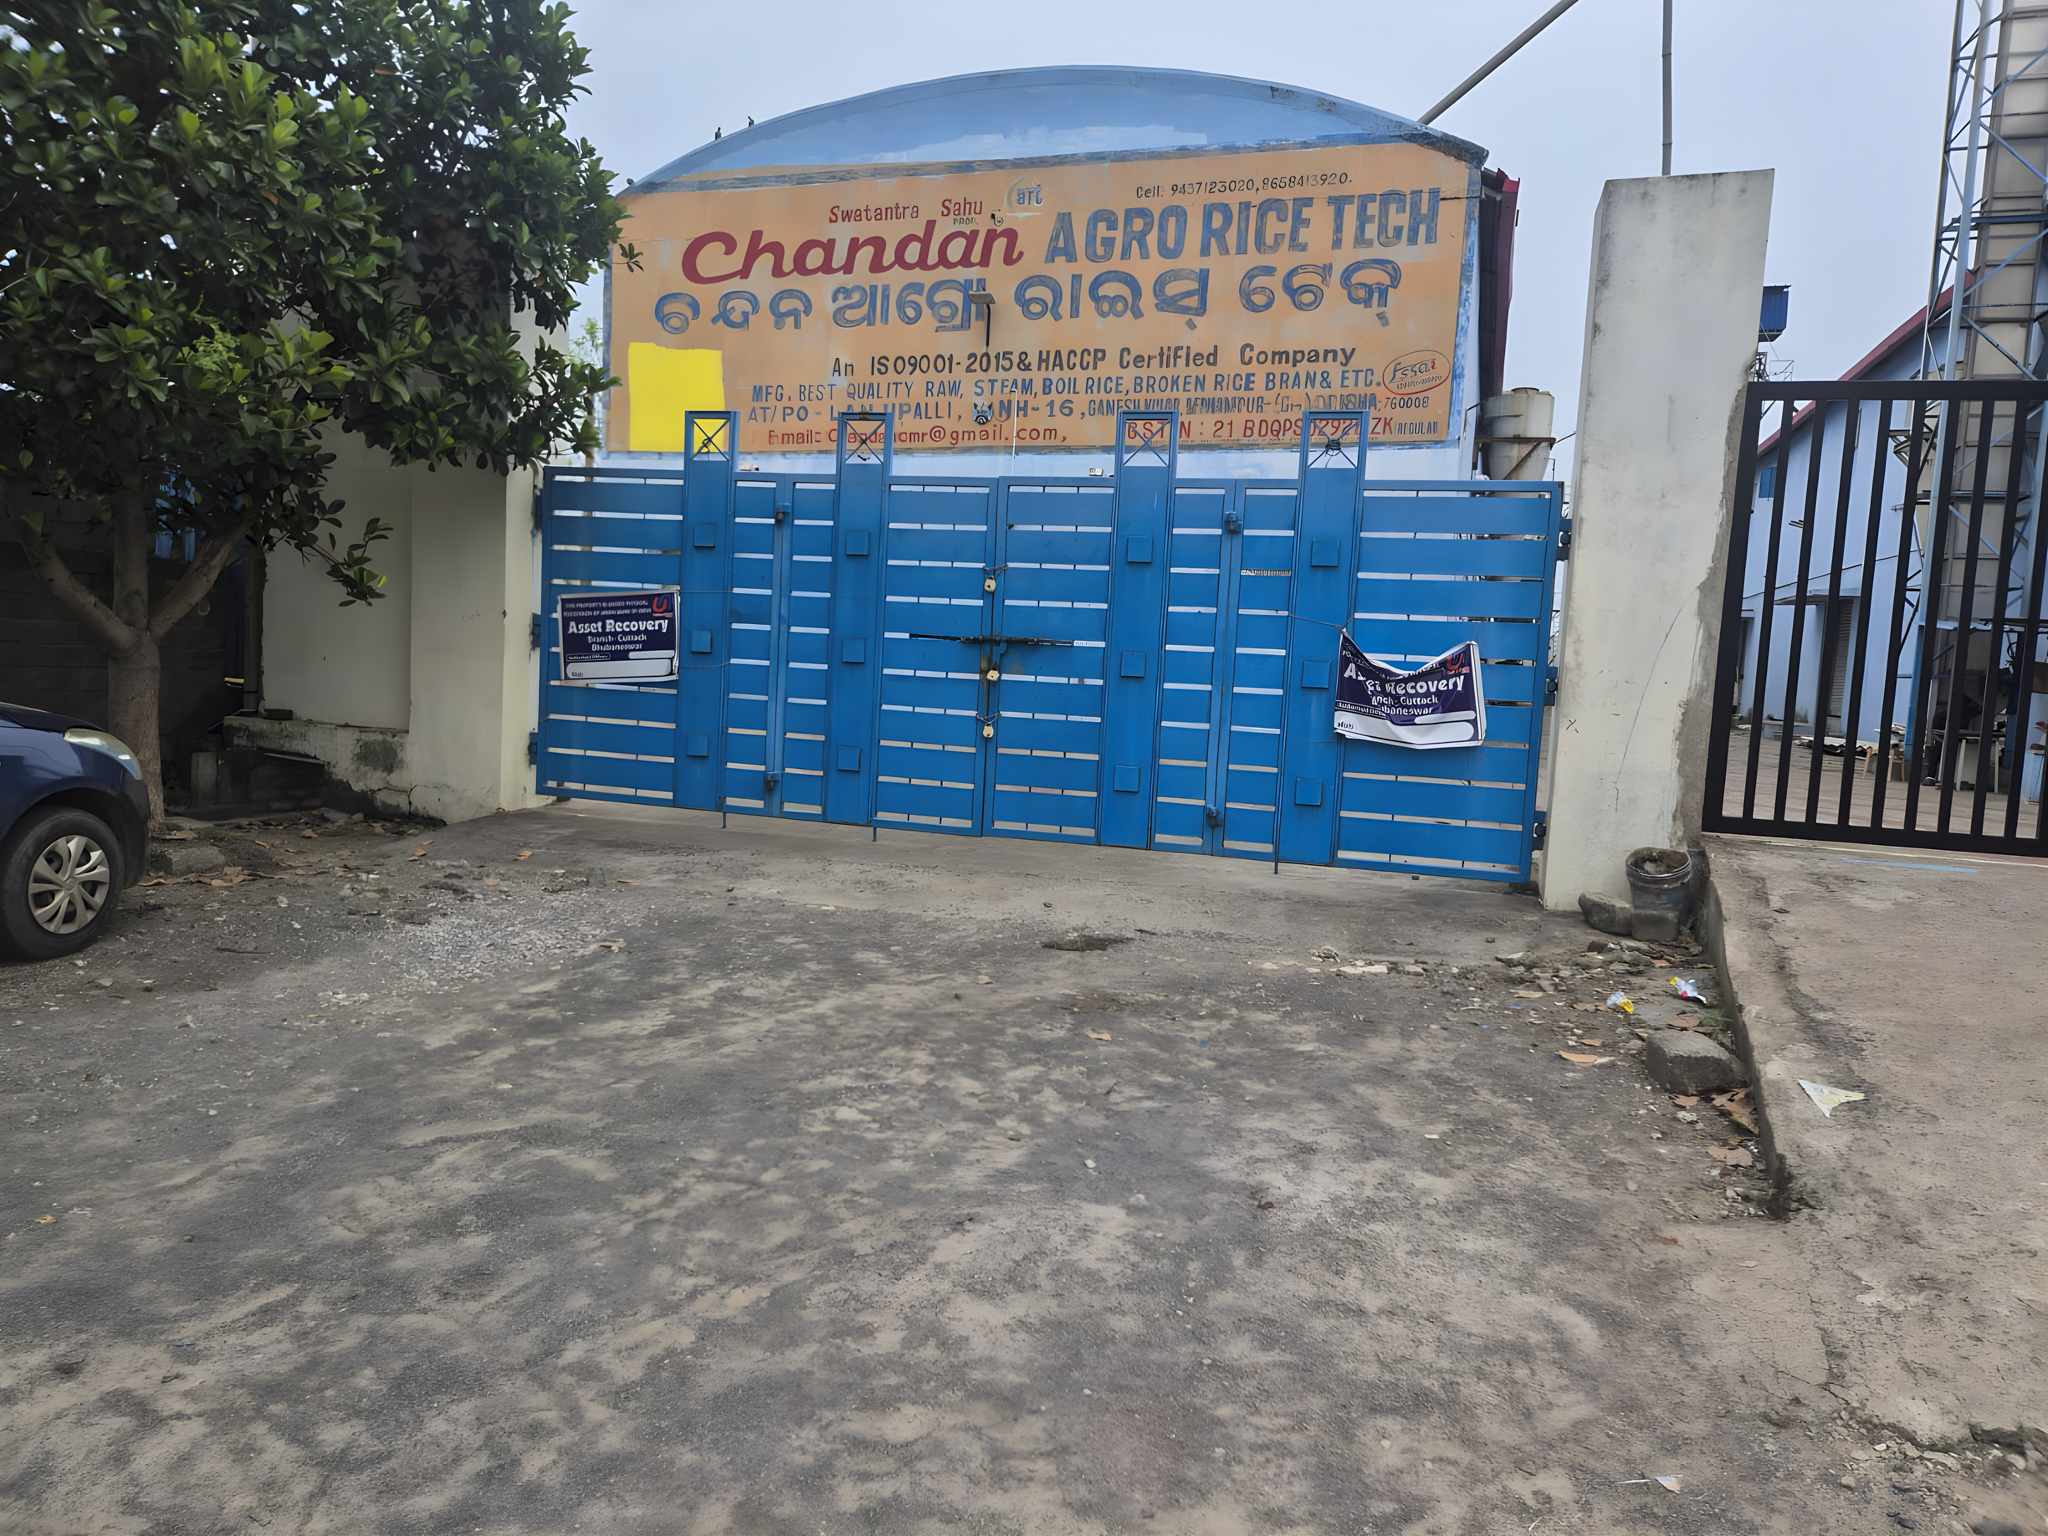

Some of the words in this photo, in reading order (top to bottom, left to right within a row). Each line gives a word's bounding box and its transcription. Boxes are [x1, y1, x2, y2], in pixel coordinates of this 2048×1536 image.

[829, 202, 919, 224] Swatantra
[941, 197, 983, 217] Sahu
[680, 220, 1024, 285] Chandan
[1044, 204, 1188, 263] AGRO
[1199, 197, 1314, 257] RICE
[1327, 187, 1441, 250] TECH
[832, 357, 855, 377] An
[1239, 343, 1357, 367] Company
[751, 384, 792, 402] MFG.
[799, 383, 837, 402] BEST
[846, 380, 914, 401] QUALITY
[925, 379, 964, 399] RAW,
[1213, 372, 1256, 392] RICE
[1127, 419, 1192, 440] GSTN
[567, 620, 603, 634] Asset
[605, 619, 669, 633] Recovery
